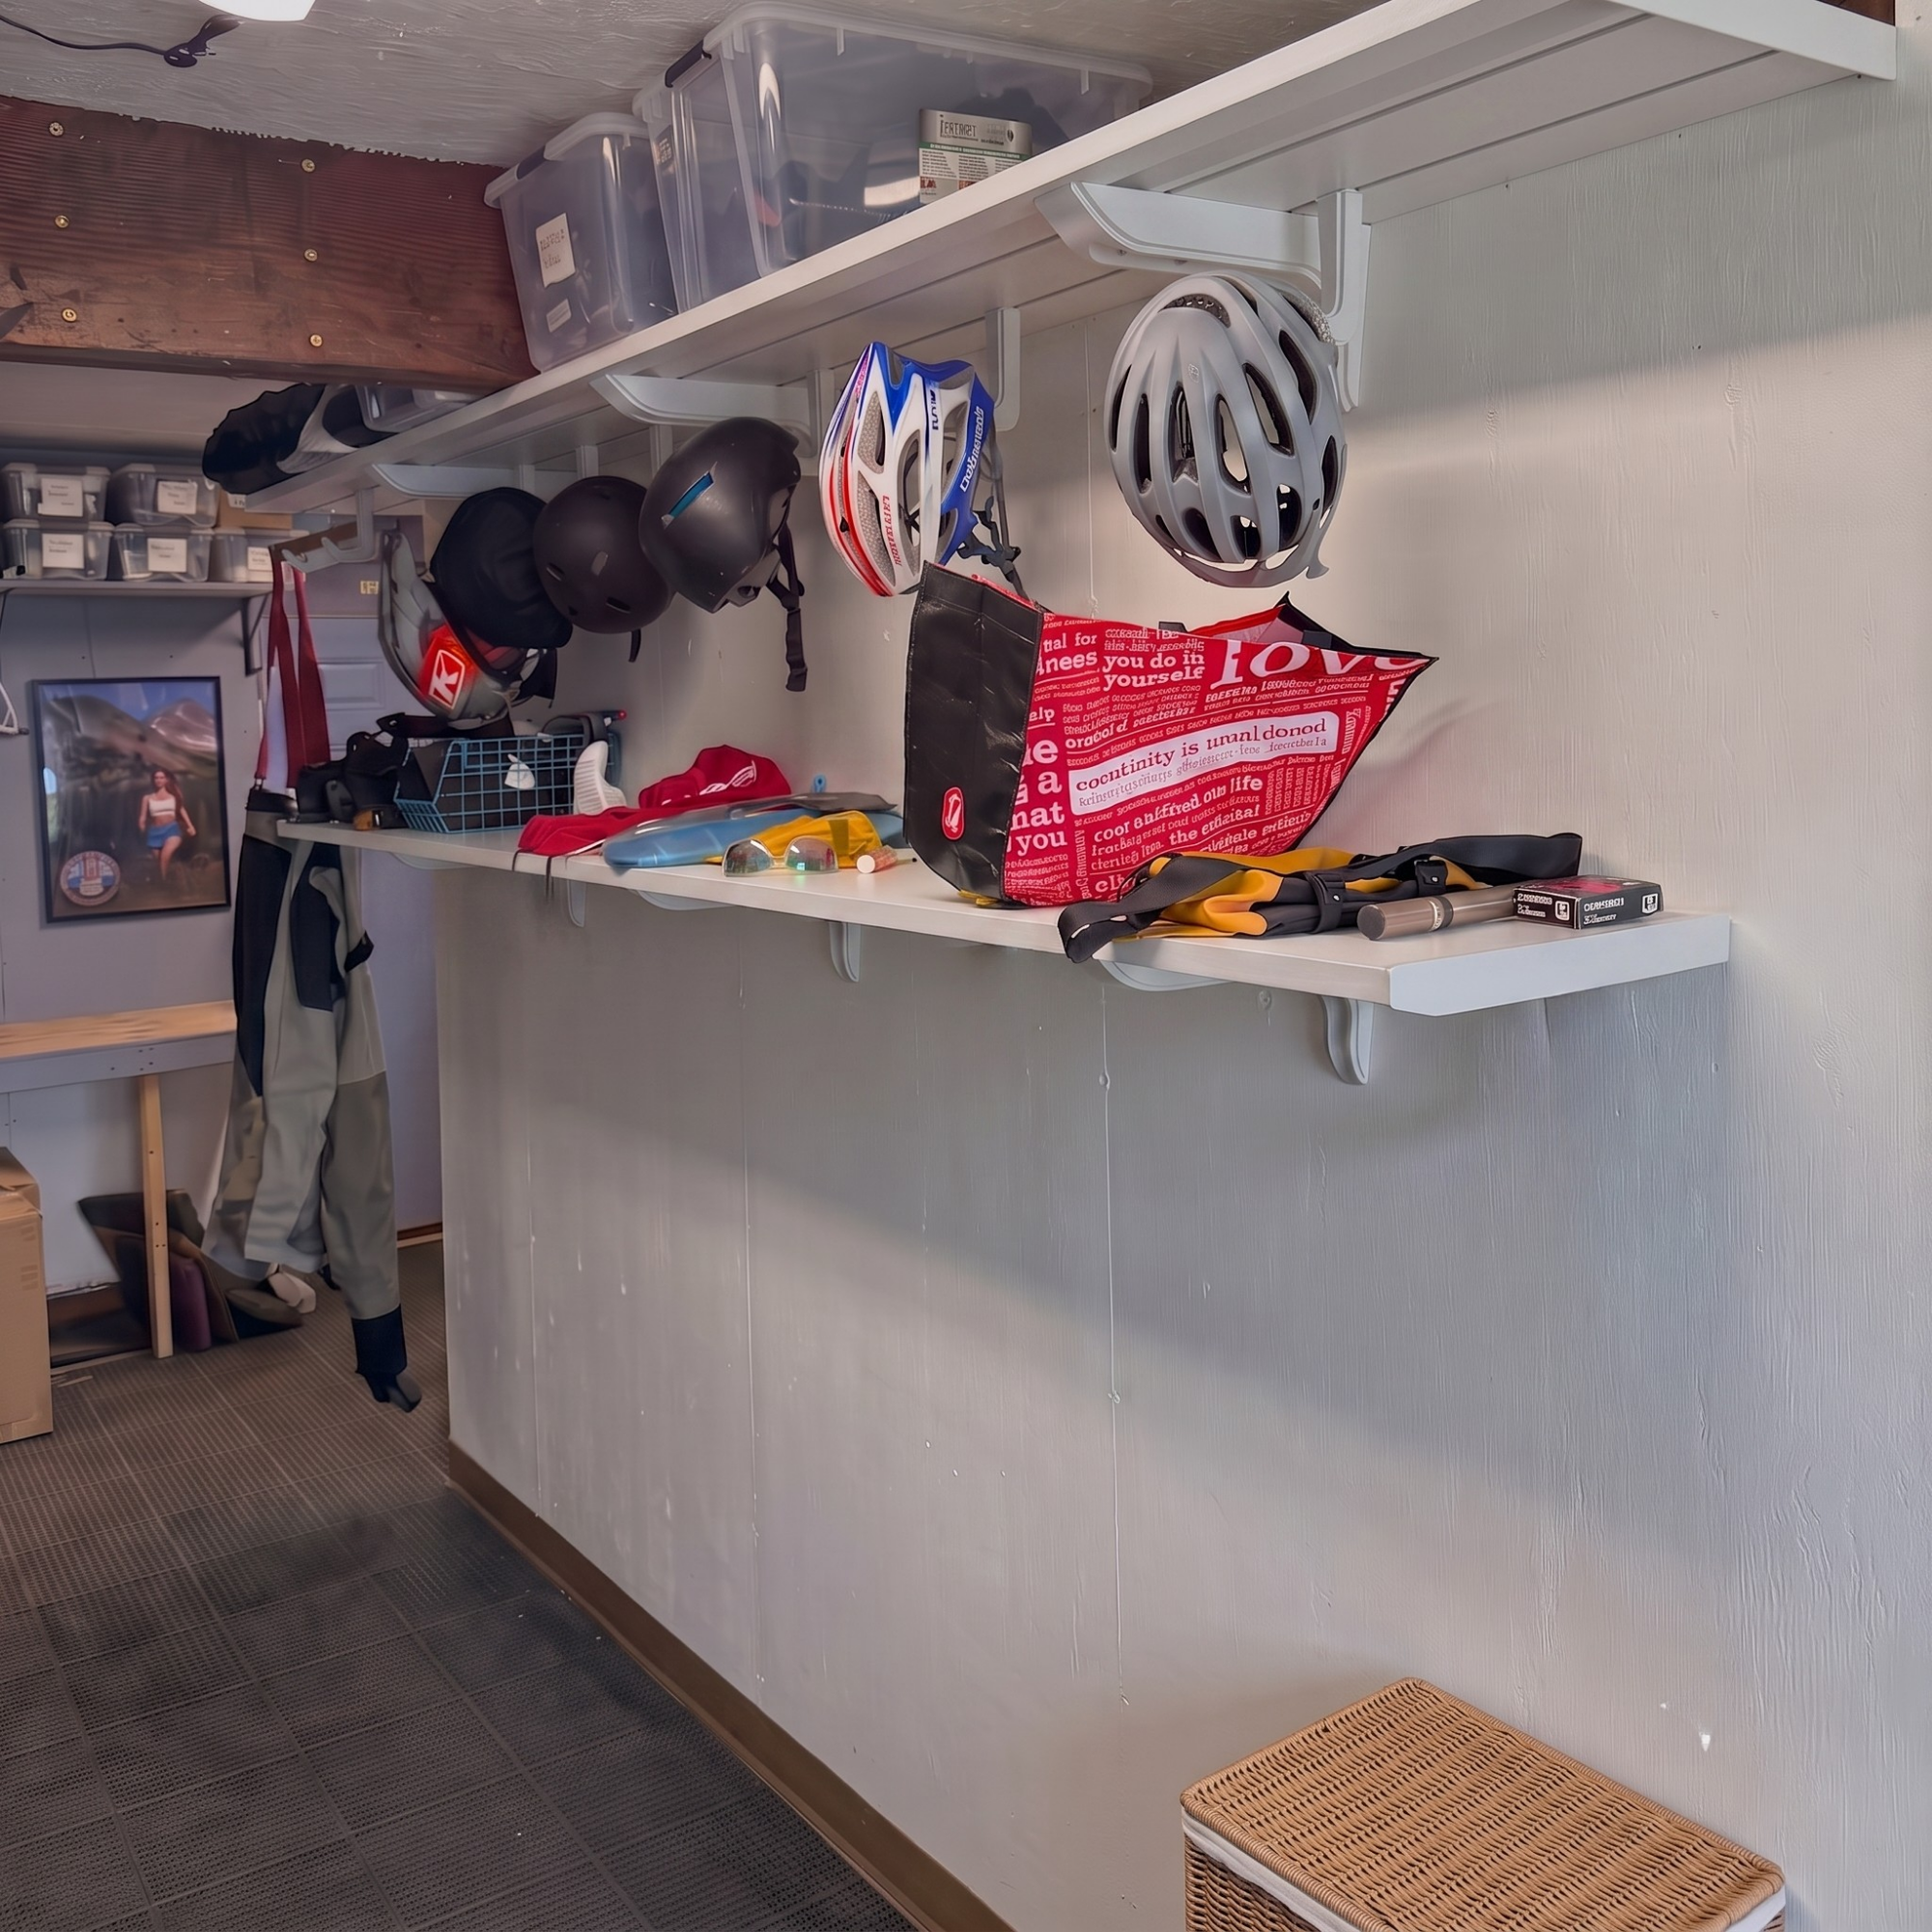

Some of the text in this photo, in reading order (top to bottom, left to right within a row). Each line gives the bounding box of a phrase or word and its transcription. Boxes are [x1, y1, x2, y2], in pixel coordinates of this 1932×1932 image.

[1074, 632, 1097, 646] for
[1102, 655, 1145, 673] you
[1150, 652, 1177, 668] do
[1102, 666, 1206, 692] yourself
[1180, 731, 1200, 753] is
[1015, 830, 1068, 856] you
[1169, 829, 1198, 846] the
